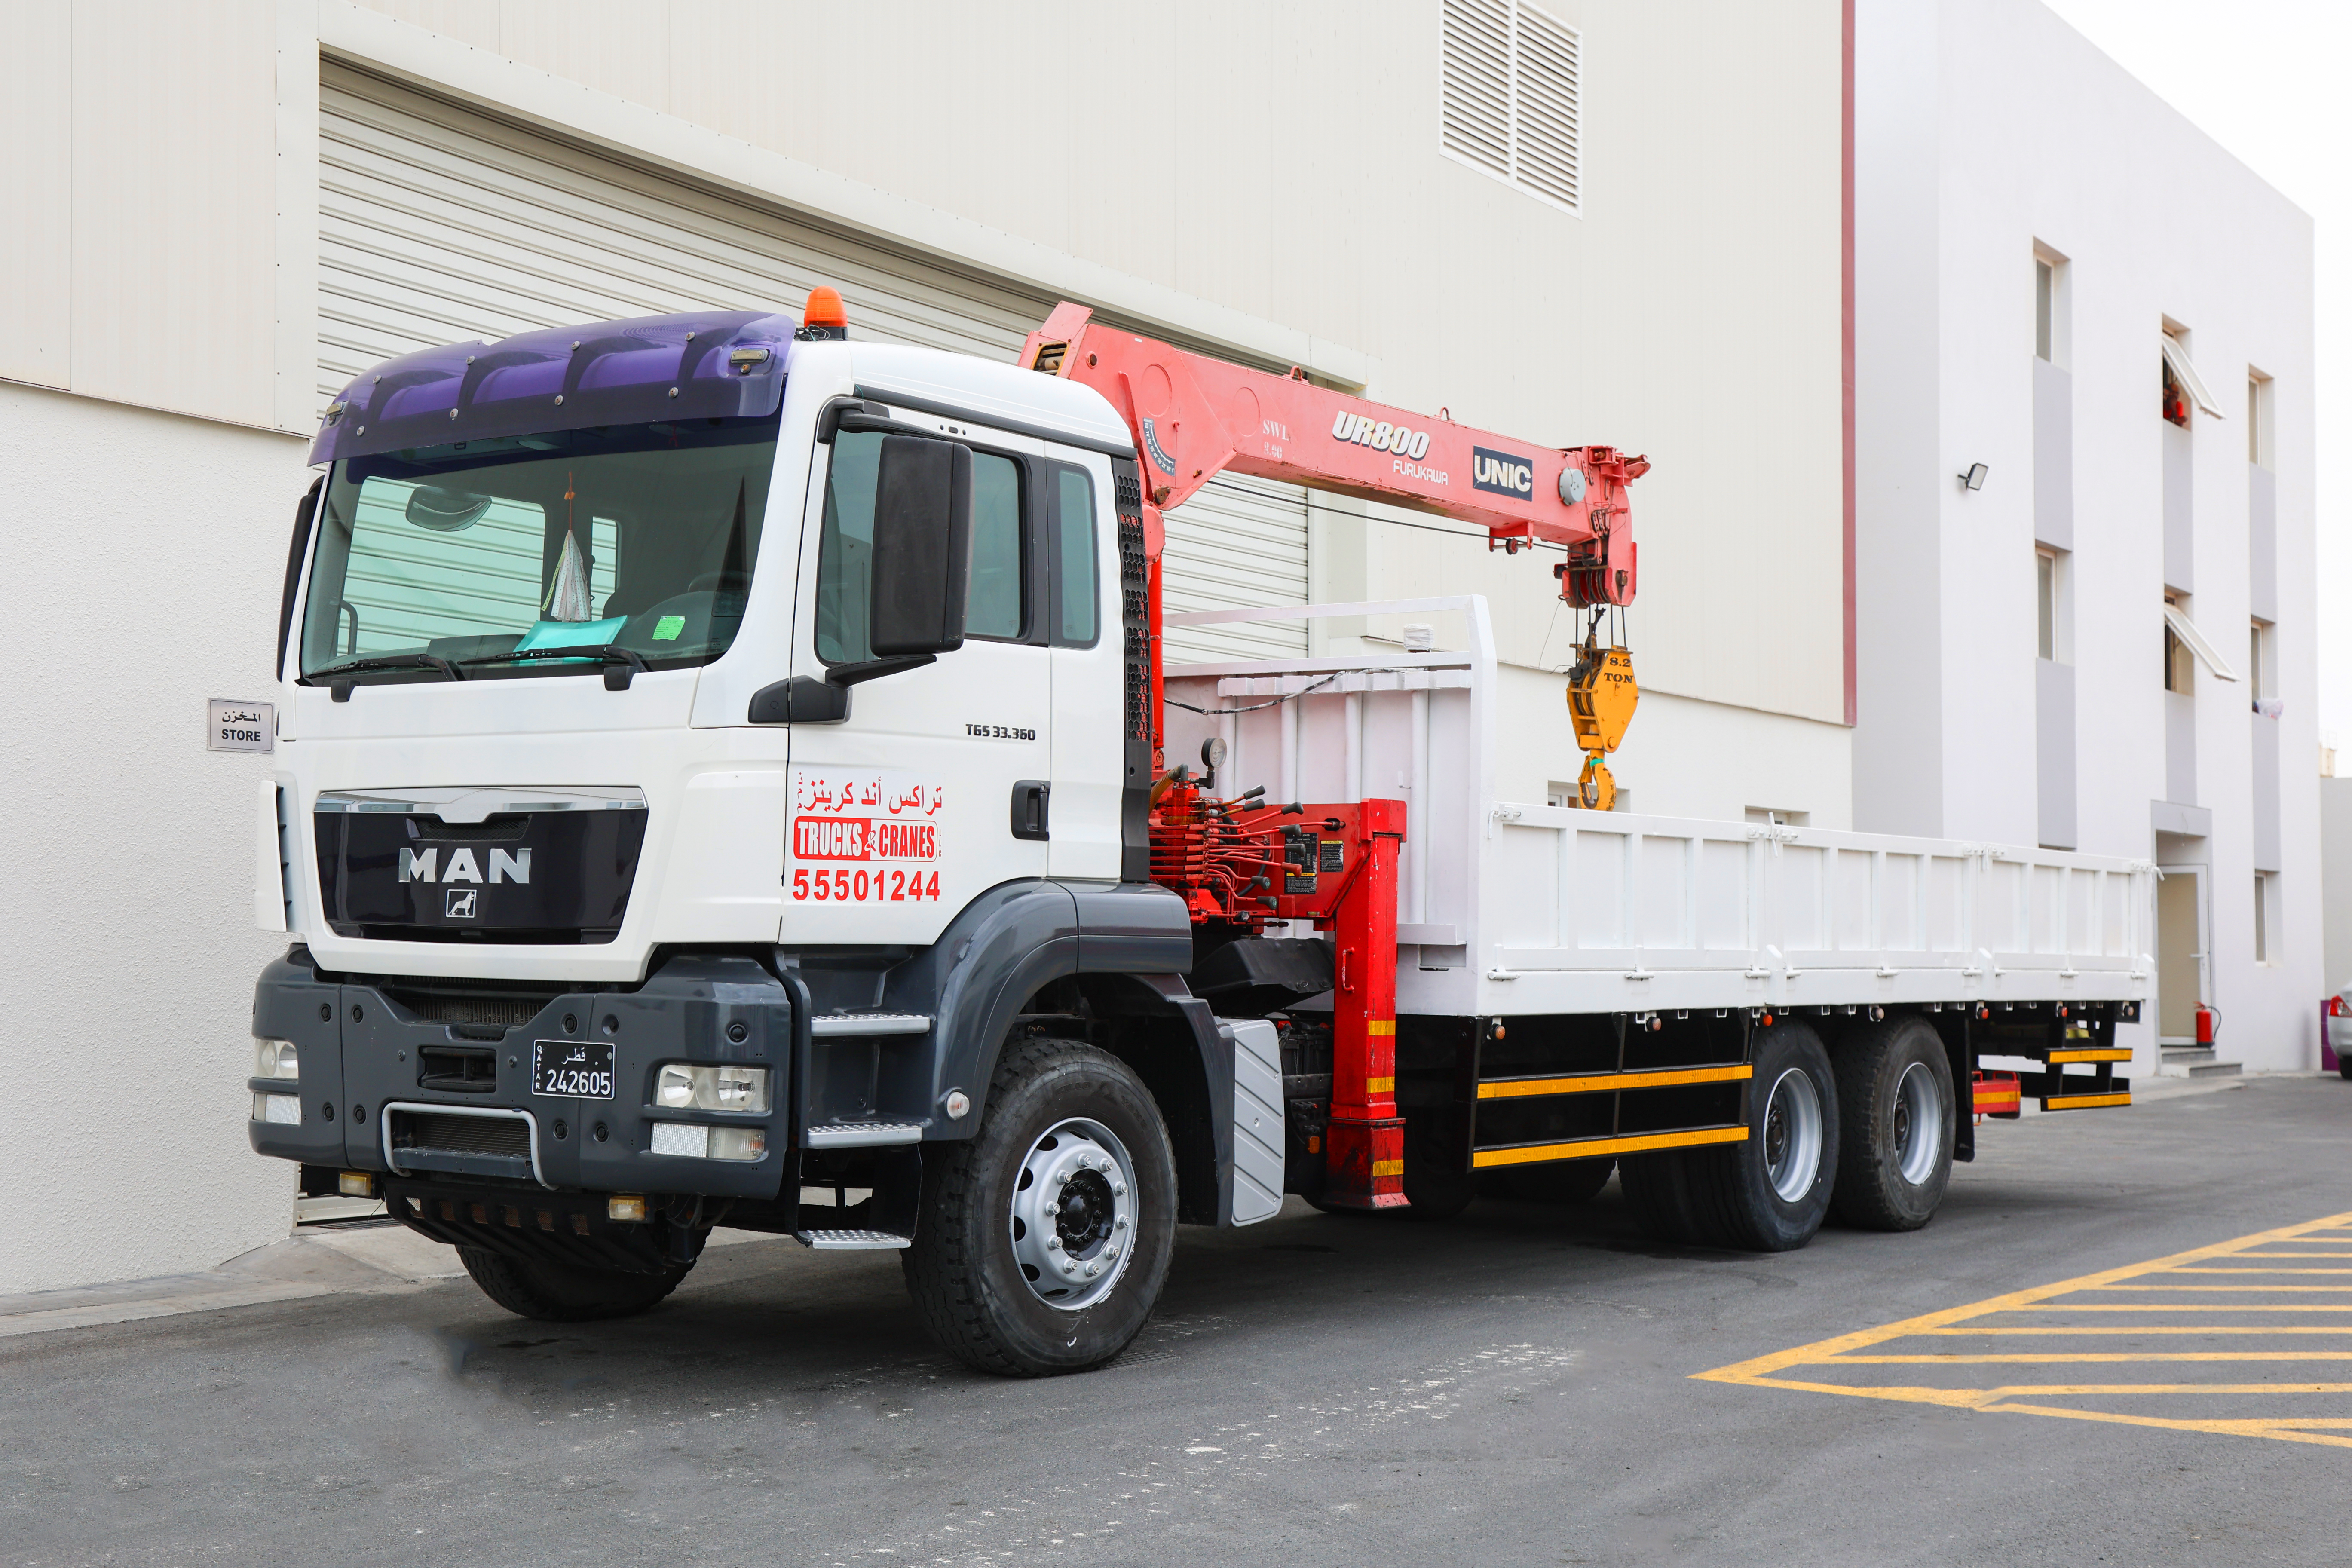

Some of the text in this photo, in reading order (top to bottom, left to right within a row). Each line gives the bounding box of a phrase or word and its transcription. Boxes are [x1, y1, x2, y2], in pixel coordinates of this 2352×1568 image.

[1262, 419, 1289, 441] SWL
[1332, 410, 1430, 461] UR800
[1393, 459, 1448, 485] FURUKAWA
[1474, 455, 1531, 492] UNIC
[1610, 657, 1631, 667] 8.2
[1604, 672, 1634, 683] TON
[222, 710, 261, 723] المخزن
[221, 729, 261, 742] STORE
[965, 723, 1036, 741] TGS 33.360
[803, 776, 942, 816] تراكس أند كرينز
[797, 821, 935, 858] TRUCKS & CRANES
[398, 847, 532, 884] MAN
[792, 869, 940, 901] 55501244
[561, 1047, 586, 1065] قطر
[546, 1069, 611, 1095] 242605
